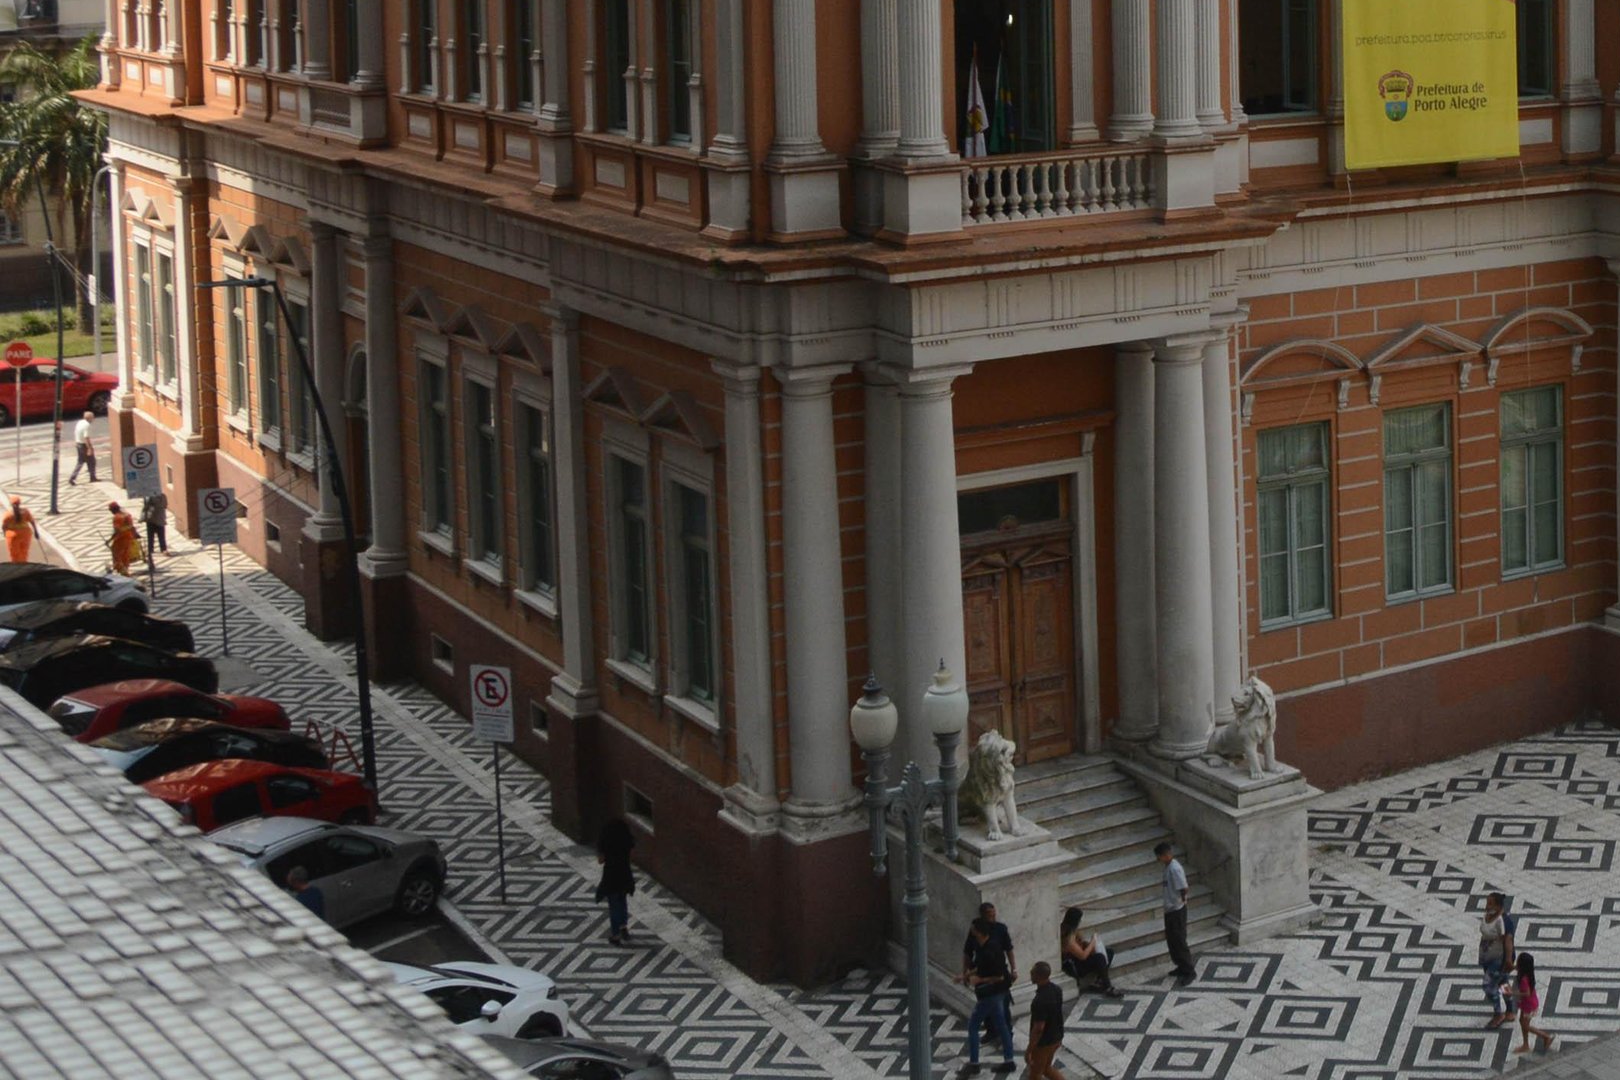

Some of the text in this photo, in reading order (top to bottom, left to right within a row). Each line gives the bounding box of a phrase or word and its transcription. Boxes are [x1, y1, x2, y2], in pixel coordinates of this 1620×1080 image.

[1416, 82, 1485, 97] Prefeitura de
[1414, 96, 1488, 112] Porto Alegre
[6, 350, 31, 359] PARE
